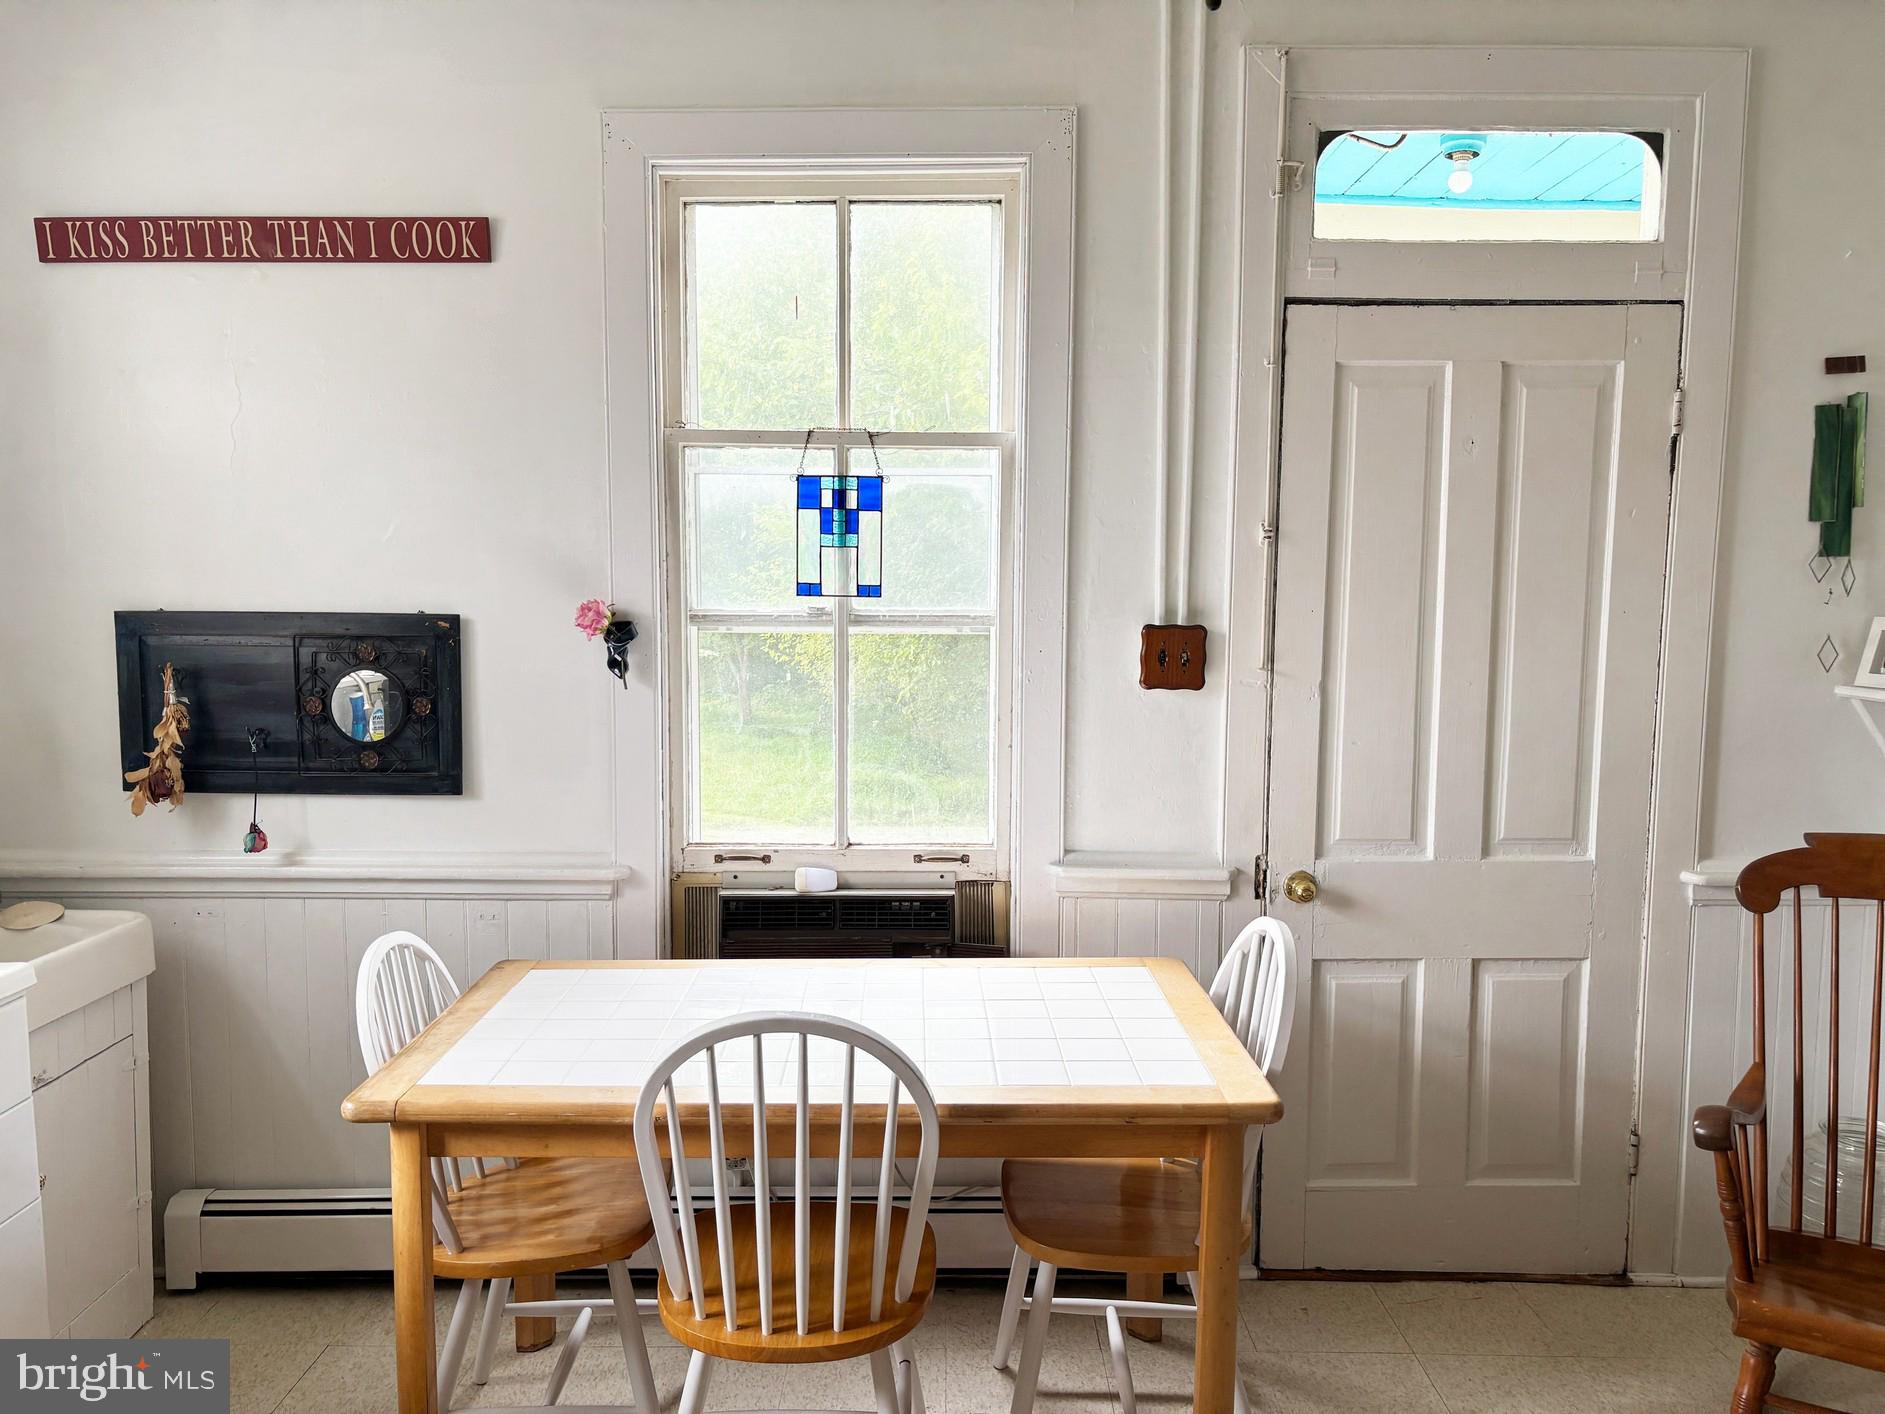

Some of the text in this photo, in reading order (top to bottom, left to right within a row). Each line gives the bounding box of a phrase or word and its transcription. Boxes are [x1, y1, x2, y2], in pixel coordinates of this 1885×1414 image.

[42, 219, 481, 259] I KISS BETTER THAN I COOK
